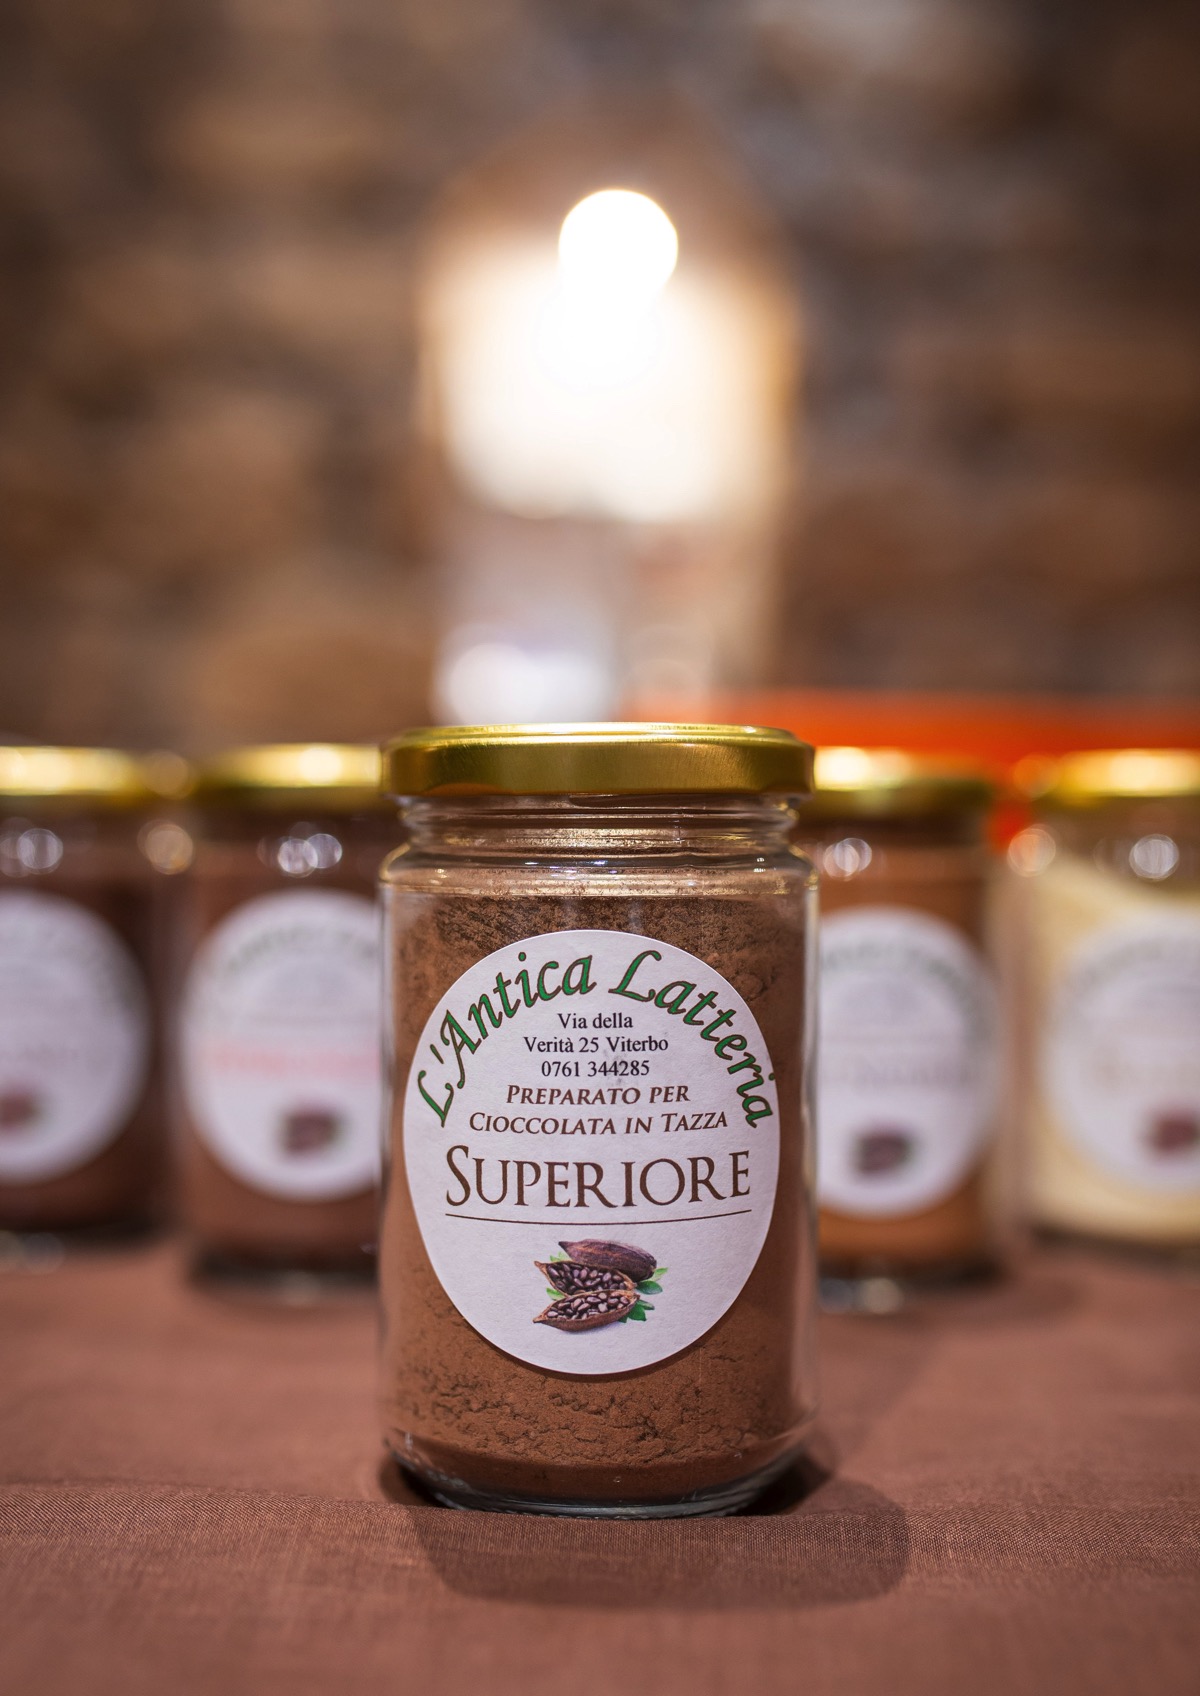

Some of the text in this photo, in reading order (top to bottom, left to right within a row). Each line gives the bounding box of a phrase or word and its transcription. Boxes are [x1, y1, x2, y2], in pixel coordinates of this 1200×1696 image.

[557, 1012, 633, 1029] Via della
[417, 951, 597, 1128] L'Antica
[608, 949, 776, 1129] Latteria
[523, 1035, 669, 1053] Verità 25 Viterbo
[541, 1059, 650, 1077] 0761 344285
[505, 1084, 690, 1106] PREPARATO PER
[469, 1110, 728, 1135] CIOCCOLATA IN TAZZA
[445, 1144, 751, 1208] SUPERIORE
